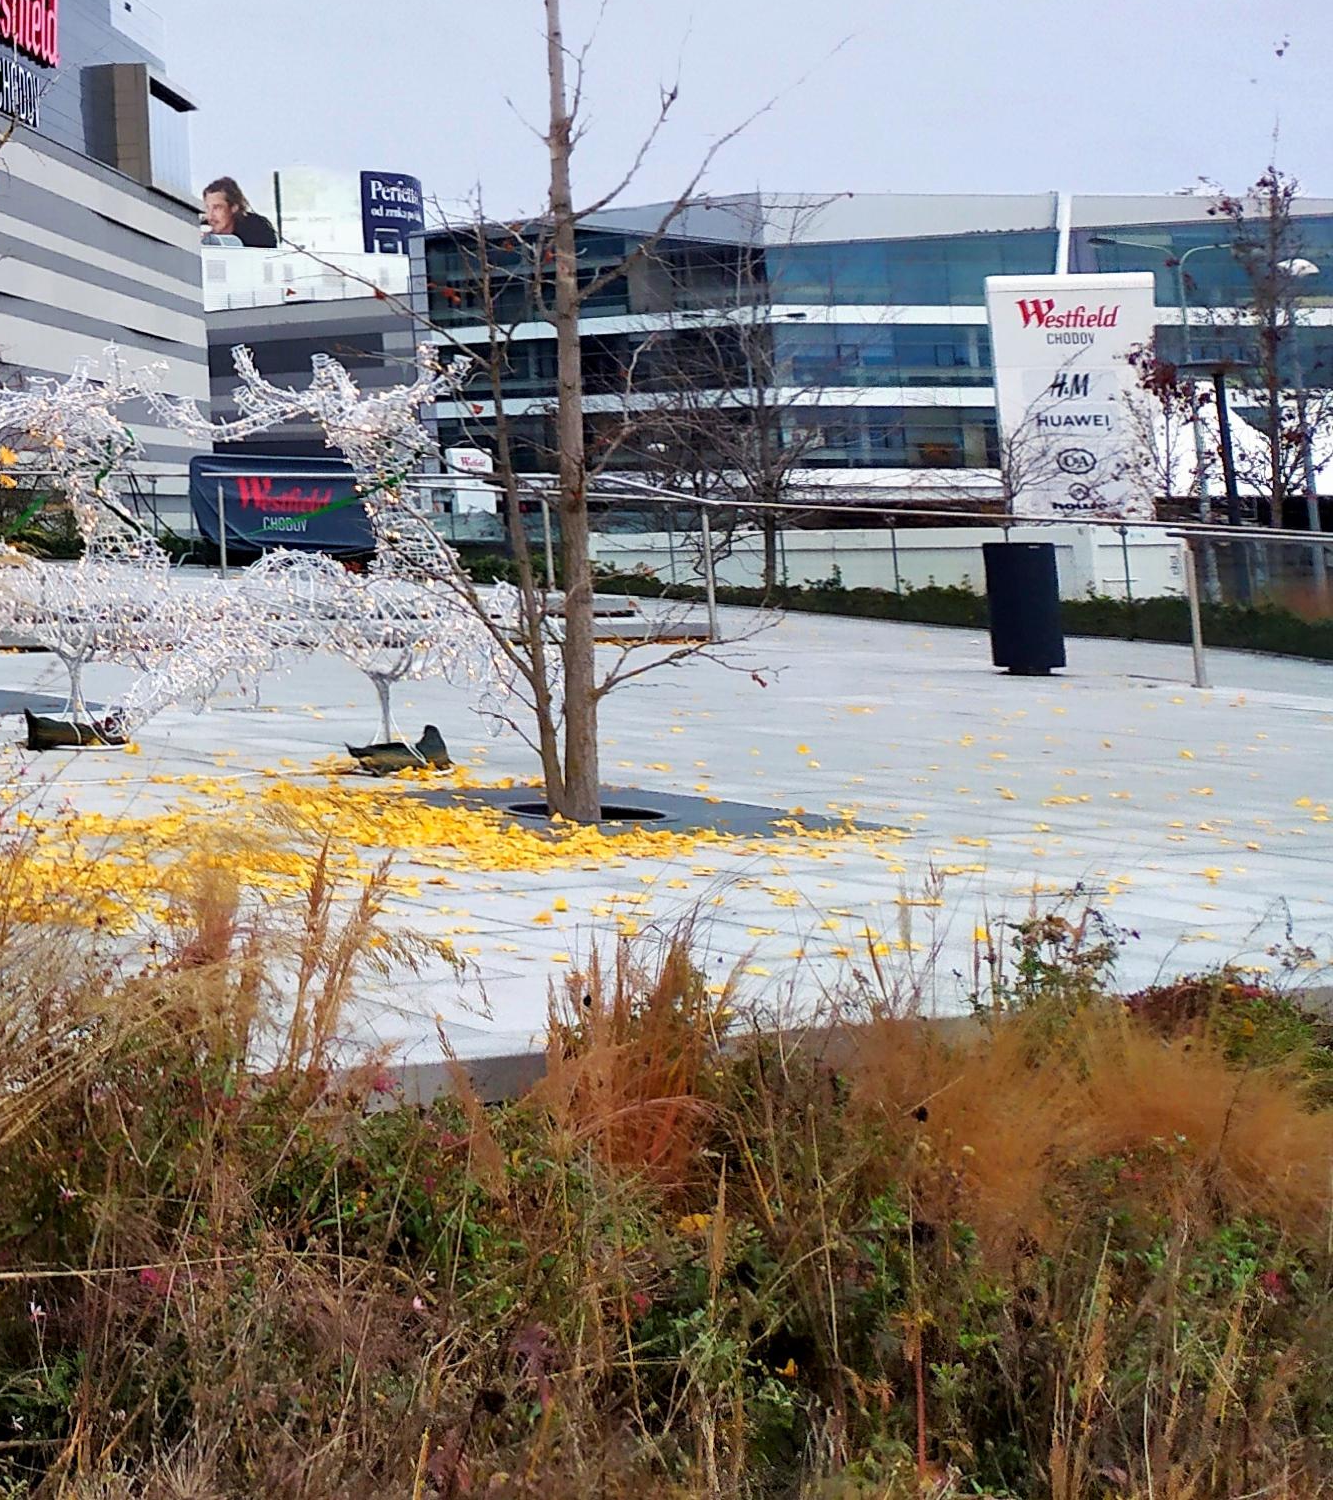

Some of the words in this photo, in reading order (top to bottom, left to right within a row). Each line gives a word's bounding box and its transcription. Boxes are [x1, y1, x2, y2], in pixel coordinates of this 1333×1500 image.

[1015, 299, 1121, 328] Westfield
[1046, 332, 1095, 344] CHODOV
[1050, 373, 1090, 397] H&M
[1037, 414, 1110, 427] HUAWEI
[236, 476, 334, 513] Westfield
